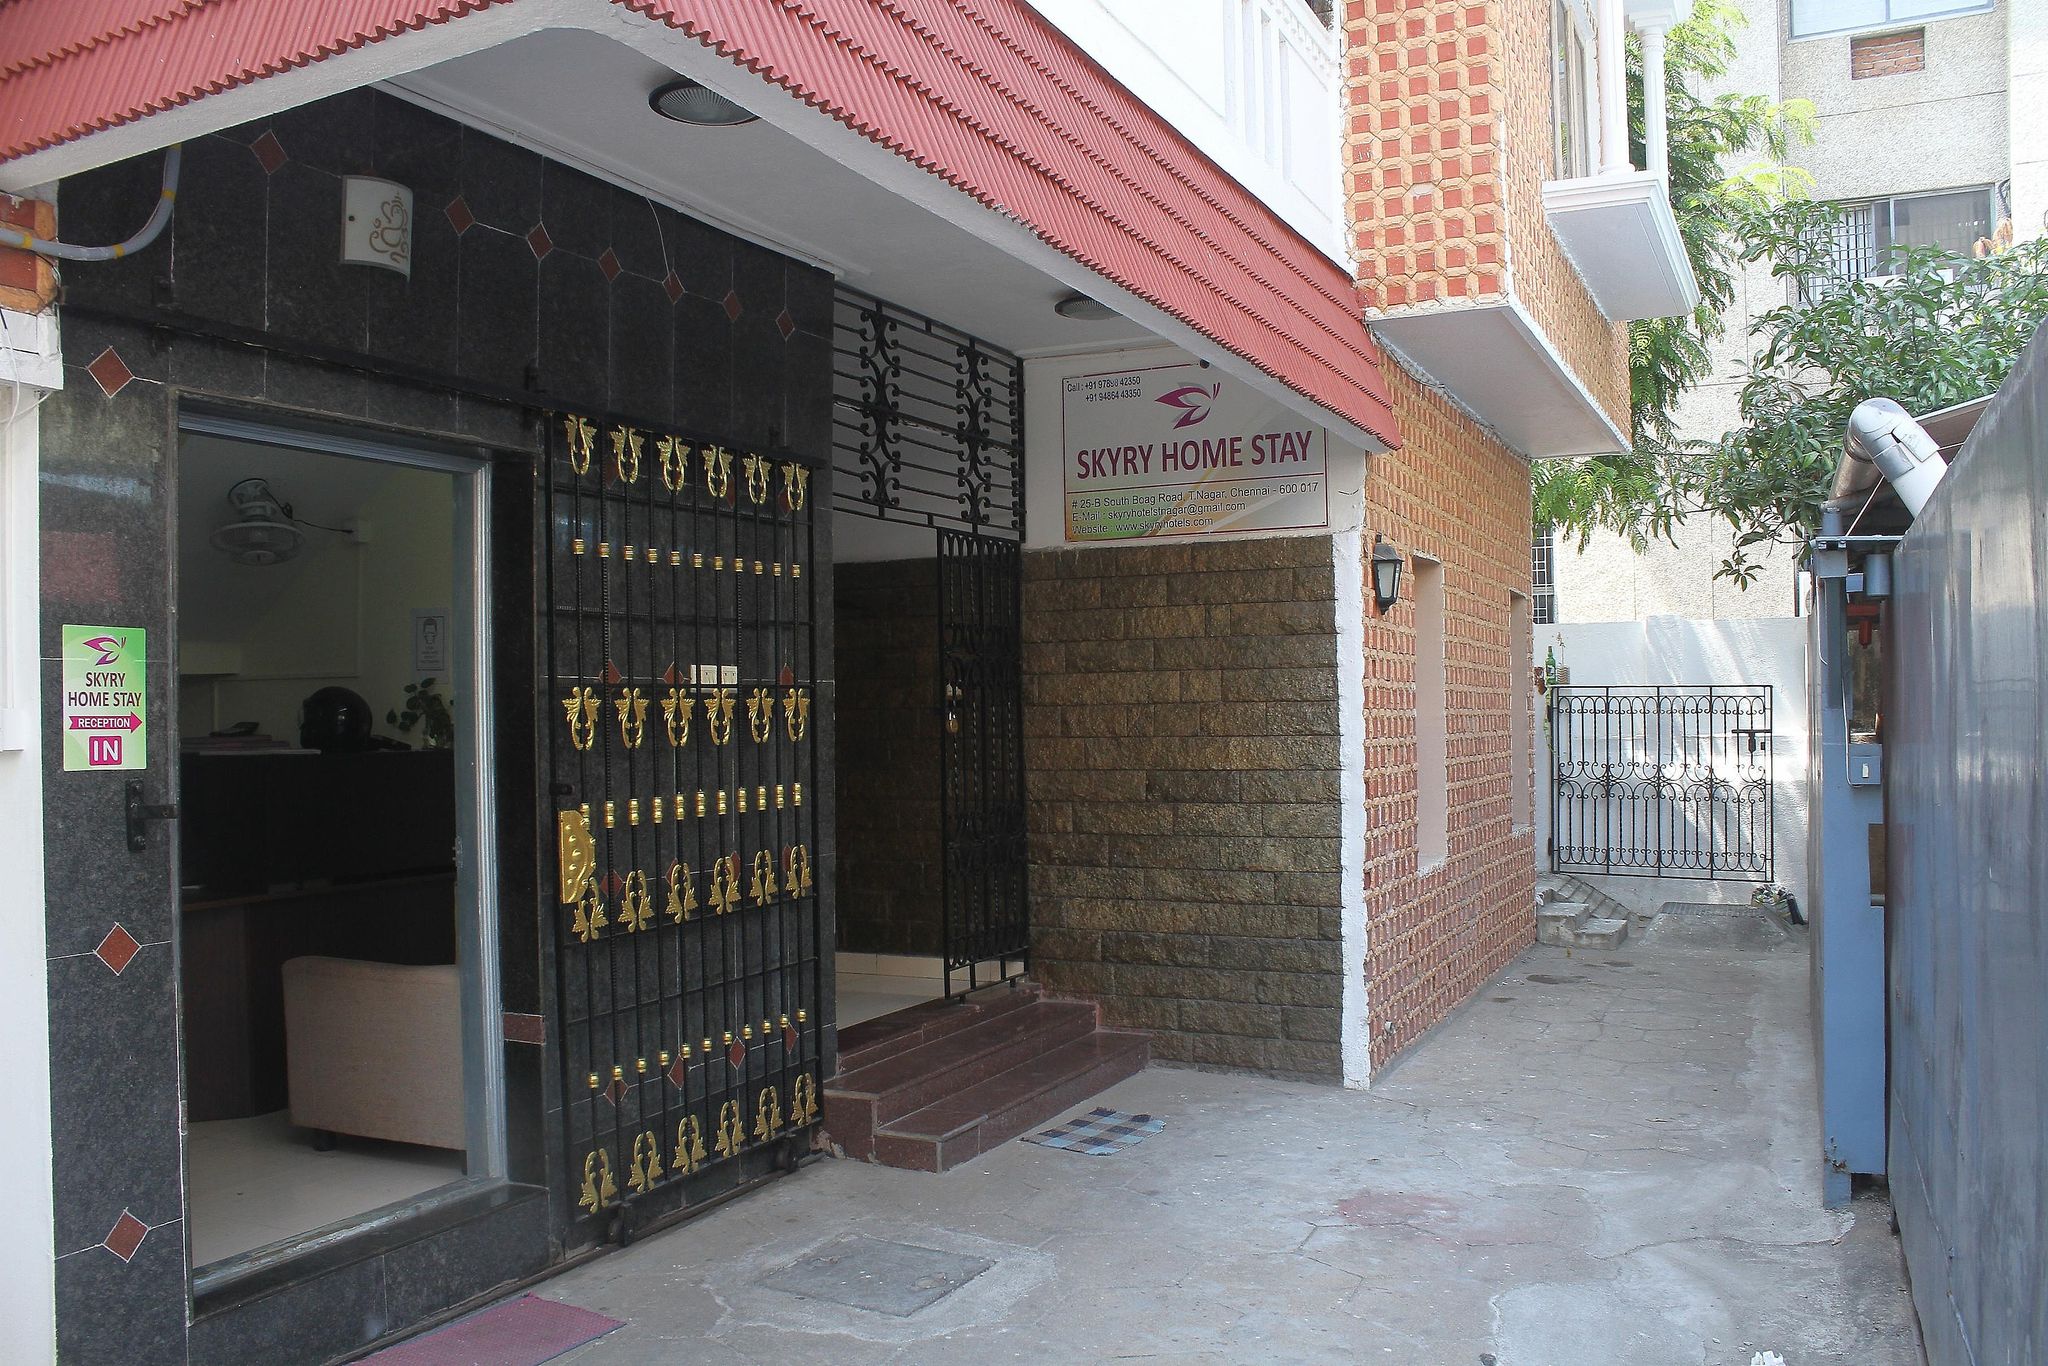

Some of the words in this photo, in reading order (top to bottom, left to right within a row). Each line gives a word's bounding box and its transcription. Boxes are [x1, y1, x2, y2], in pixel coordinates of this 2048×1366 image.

[1067, 382, 1080, 393] Call
[1085, 381, 1097, 391] +91
[1120, 376, 1141, 387] 42350
[1086, 393, 1097, 402] +91
[1120, 389, 1142, 399] 43350
[1077, 444, 1154, 480] SKYRY
[1162, 436, 1243, 473] HOME
[1251, 430, 1313, 466] STAY
[1080, 498, 1101, 509] 25-B
[1104, 496, 1130, 507] South
[1132, 494, 1156, 506] Boag
[1230, 485, 1271, 498] Chennai
[1279, 483, 1298, 494] 600
[1300, 482, 1319, 492] 017
[1072, 511, 1100, 522] E-Mail
[1108, 502, 1246, 519] skyryhotelstnagar@gmail.com
[1072, 525, 1108, 536] Website
[1115, 517, 1214, 533] www.skyryhotels.com
[86, 672, 125, 687] SKYRY
[68, 691, 110, 707] HOME
[113, 692, 142, 707] STAY
[78, 718, 130, 728] RECEPTION
[93, 739, 119, 762] IN
